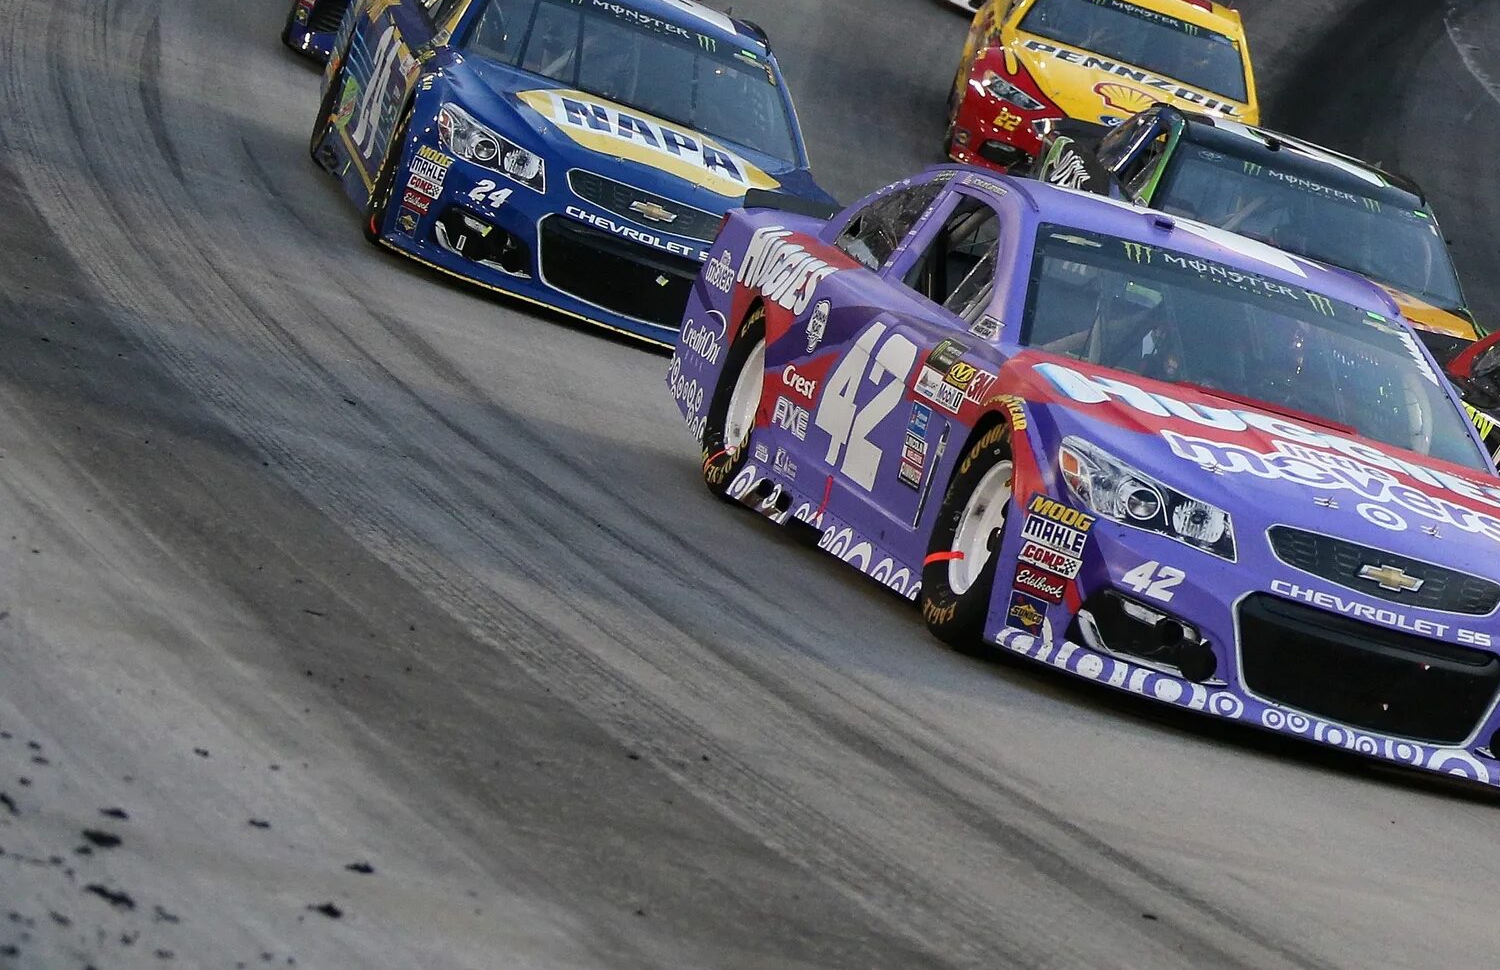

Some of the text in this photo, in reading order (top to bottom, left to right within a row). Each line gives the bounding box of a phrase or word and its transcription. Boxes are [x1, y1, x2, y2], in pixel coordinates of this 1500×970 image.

[1112, 0, 1179, 26] MONSTER
[1024, 41, 1241, 114] PENNZOIL
[993, 111, 1021, 131] 22
[417, 145, 454, 167] MOOG
[560, 97, 744, 182] NAPA
[411, 157, 447, 180] MAHLE
[411, 176, 434, 194] COMP
[466, 179, 513, 208] 24
[1268, 169, 1357, 204] MONSTER
[565, 206, 694, 256] CHEVROLET
[736, 226, 839, 316] HUGGIES
[1163, 253, 1299, 301] MONSTER
[782, 364, 816, 400] Crest
[772, 395, 809, 441] AXE
[815, 321, 918, 492] 42
[1028, 496, 1094, 530] MOOG
[1023, 517, 1084, 553] MAHLE
[1022, 544, 1065, 566] COMP
[1016, 570, 1064, 598] Edelbrock
[1122, 561, 1186, 602] 42
[1010, 605, 1044, 623] SUNOCO
[1270, 580, 1492, 647] CHEVROLET SS
